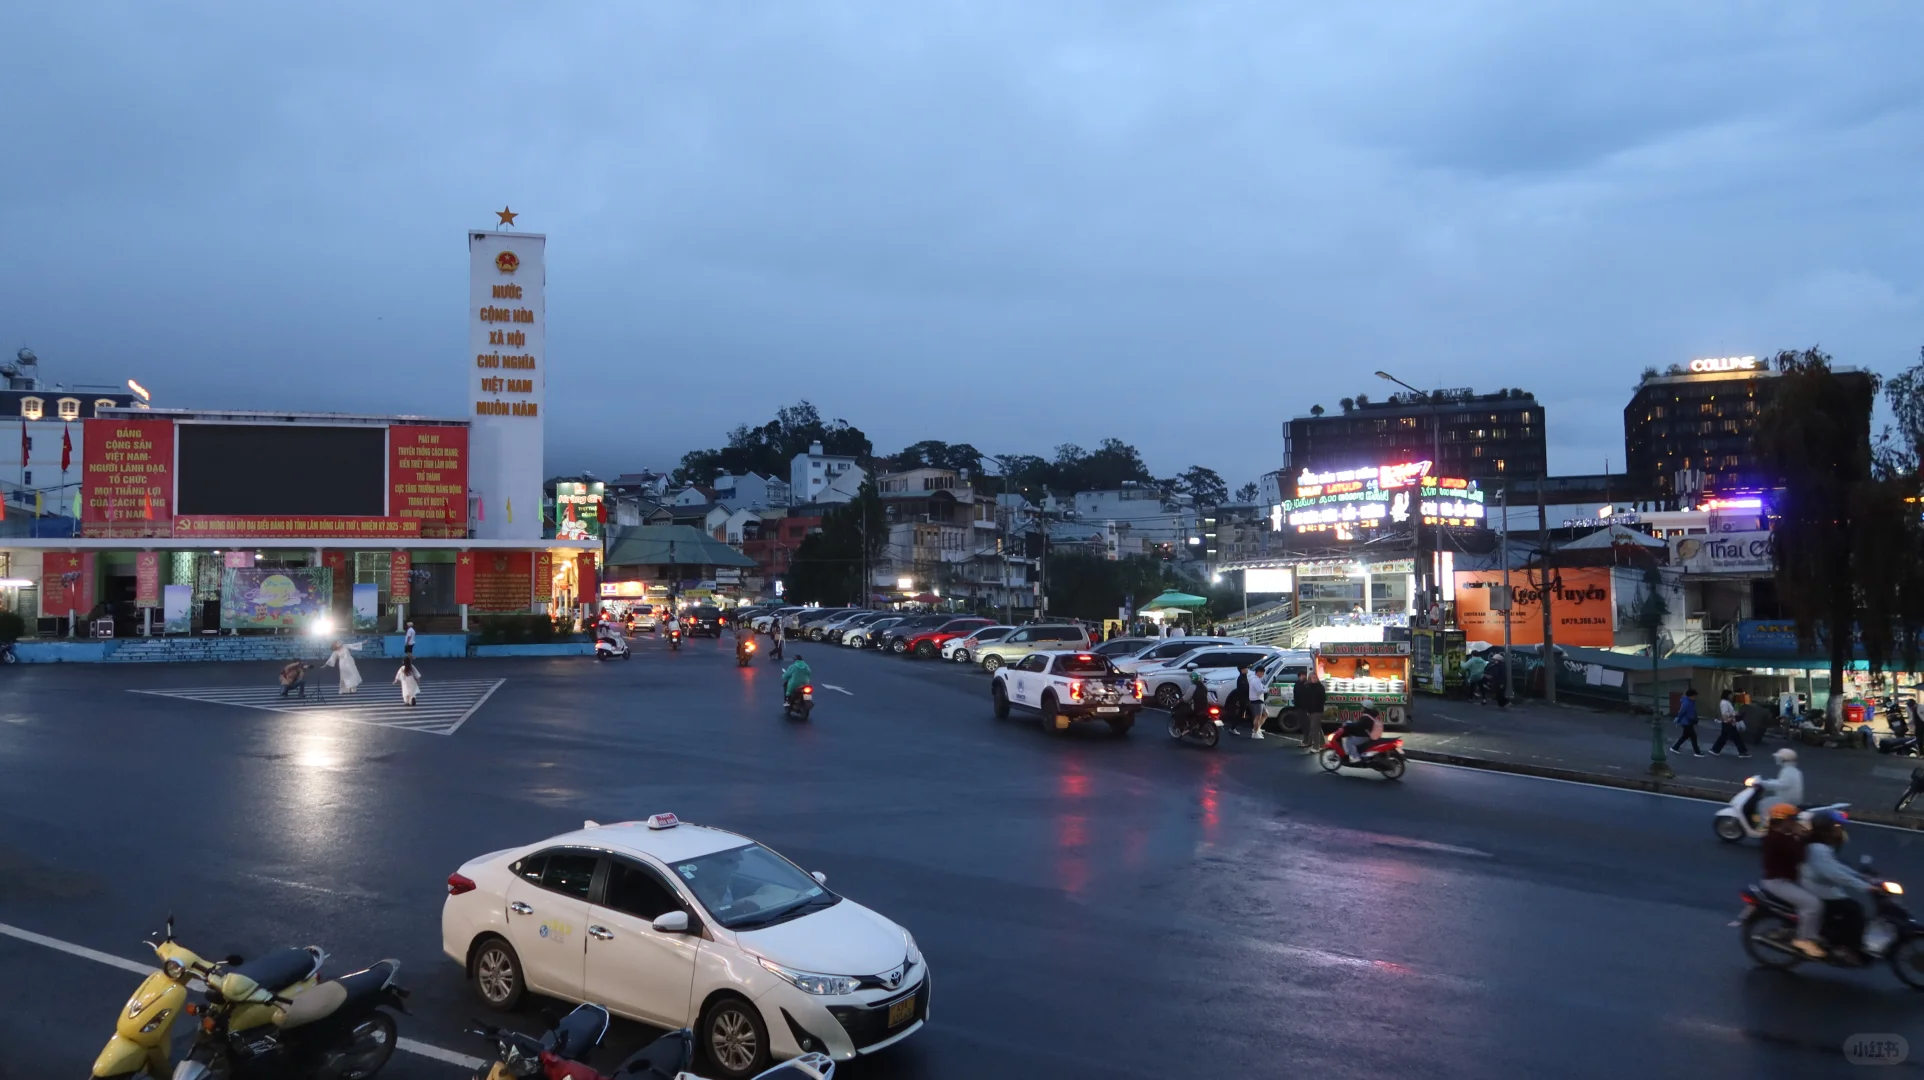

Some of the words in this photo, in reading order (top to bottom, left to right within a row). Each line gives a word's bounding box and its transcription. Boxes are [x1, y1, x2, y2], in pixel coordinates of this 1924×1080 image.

[492, 282, 522, 300] NƯỚC
[480, 306, 510, 324] CỘNG
[513, 306, 534, 324] HÒA
[489, 330, 504, 346] XÃ
[507, 331, 525, 349] HỘI
[477, 351, 500, 369] CHỦ
[502, 353, 536, 370] NGHĨA
[1690, 356, 1756, 372] COLLINE
[481, 376, 504, 394] VIỆT
[507, 378, 533, 393] NAM
[476, 398, 510, 416] MUÔN
[512, 400, 538, 417] NĂM
[116, 427, 142, 438] ĐẢNG
[418, 433, 430, 444] PHÁT
[105, 440, 131, 450] CỘNG
[133, 439, 152, 449] SẢN
[105, 452, 125, 463] VIỆT
[89, 462, 118, 472] NGƯỜI
[120, 464, 144, 472] LÃNH
[109, 472, 120, 484] TỔ
[122, 474, 148, 484] CHỨC
[116, 484, 144, 495] THẮNG
[90, 496, 108, 507] CỦA
[138, 498, 165, 507] MNG
[194, 518, 208, 530] CHÀO
[209, 518, 226, 530] MỪNG
[307, 520, 318, 530] LÂM
[386, 522, 398, 531] 2025
